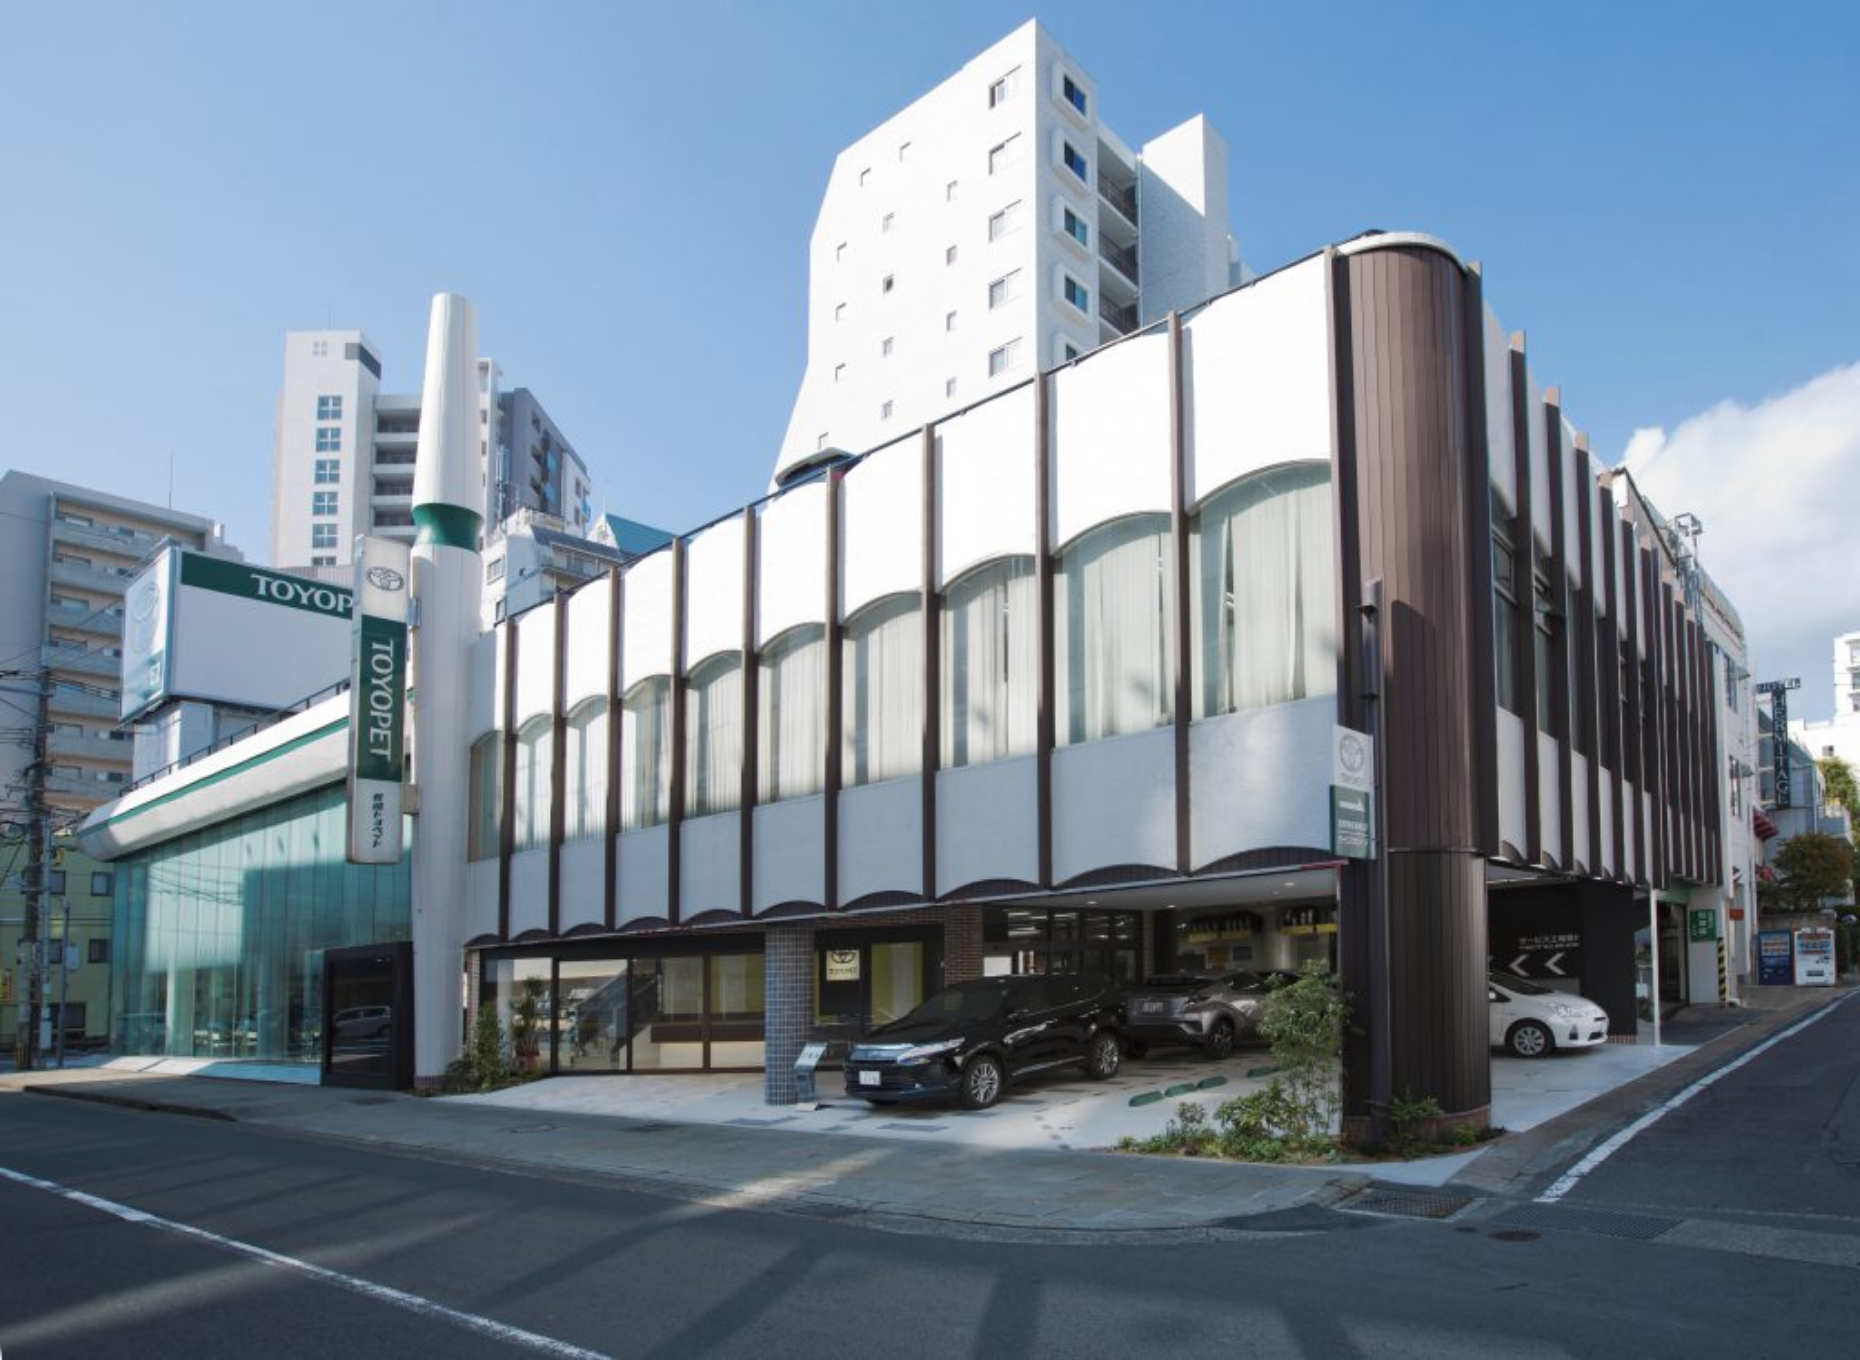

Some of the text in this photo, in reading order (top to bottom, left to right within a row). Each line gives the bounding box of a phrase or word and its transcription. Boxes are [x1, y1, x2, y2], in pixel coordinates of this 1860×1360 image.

[370, 639, 394, 761] TOYOPET
[1774, 694, 1789, 805] HERMITAGE
[371, 793, 384, 848] トヨペット
